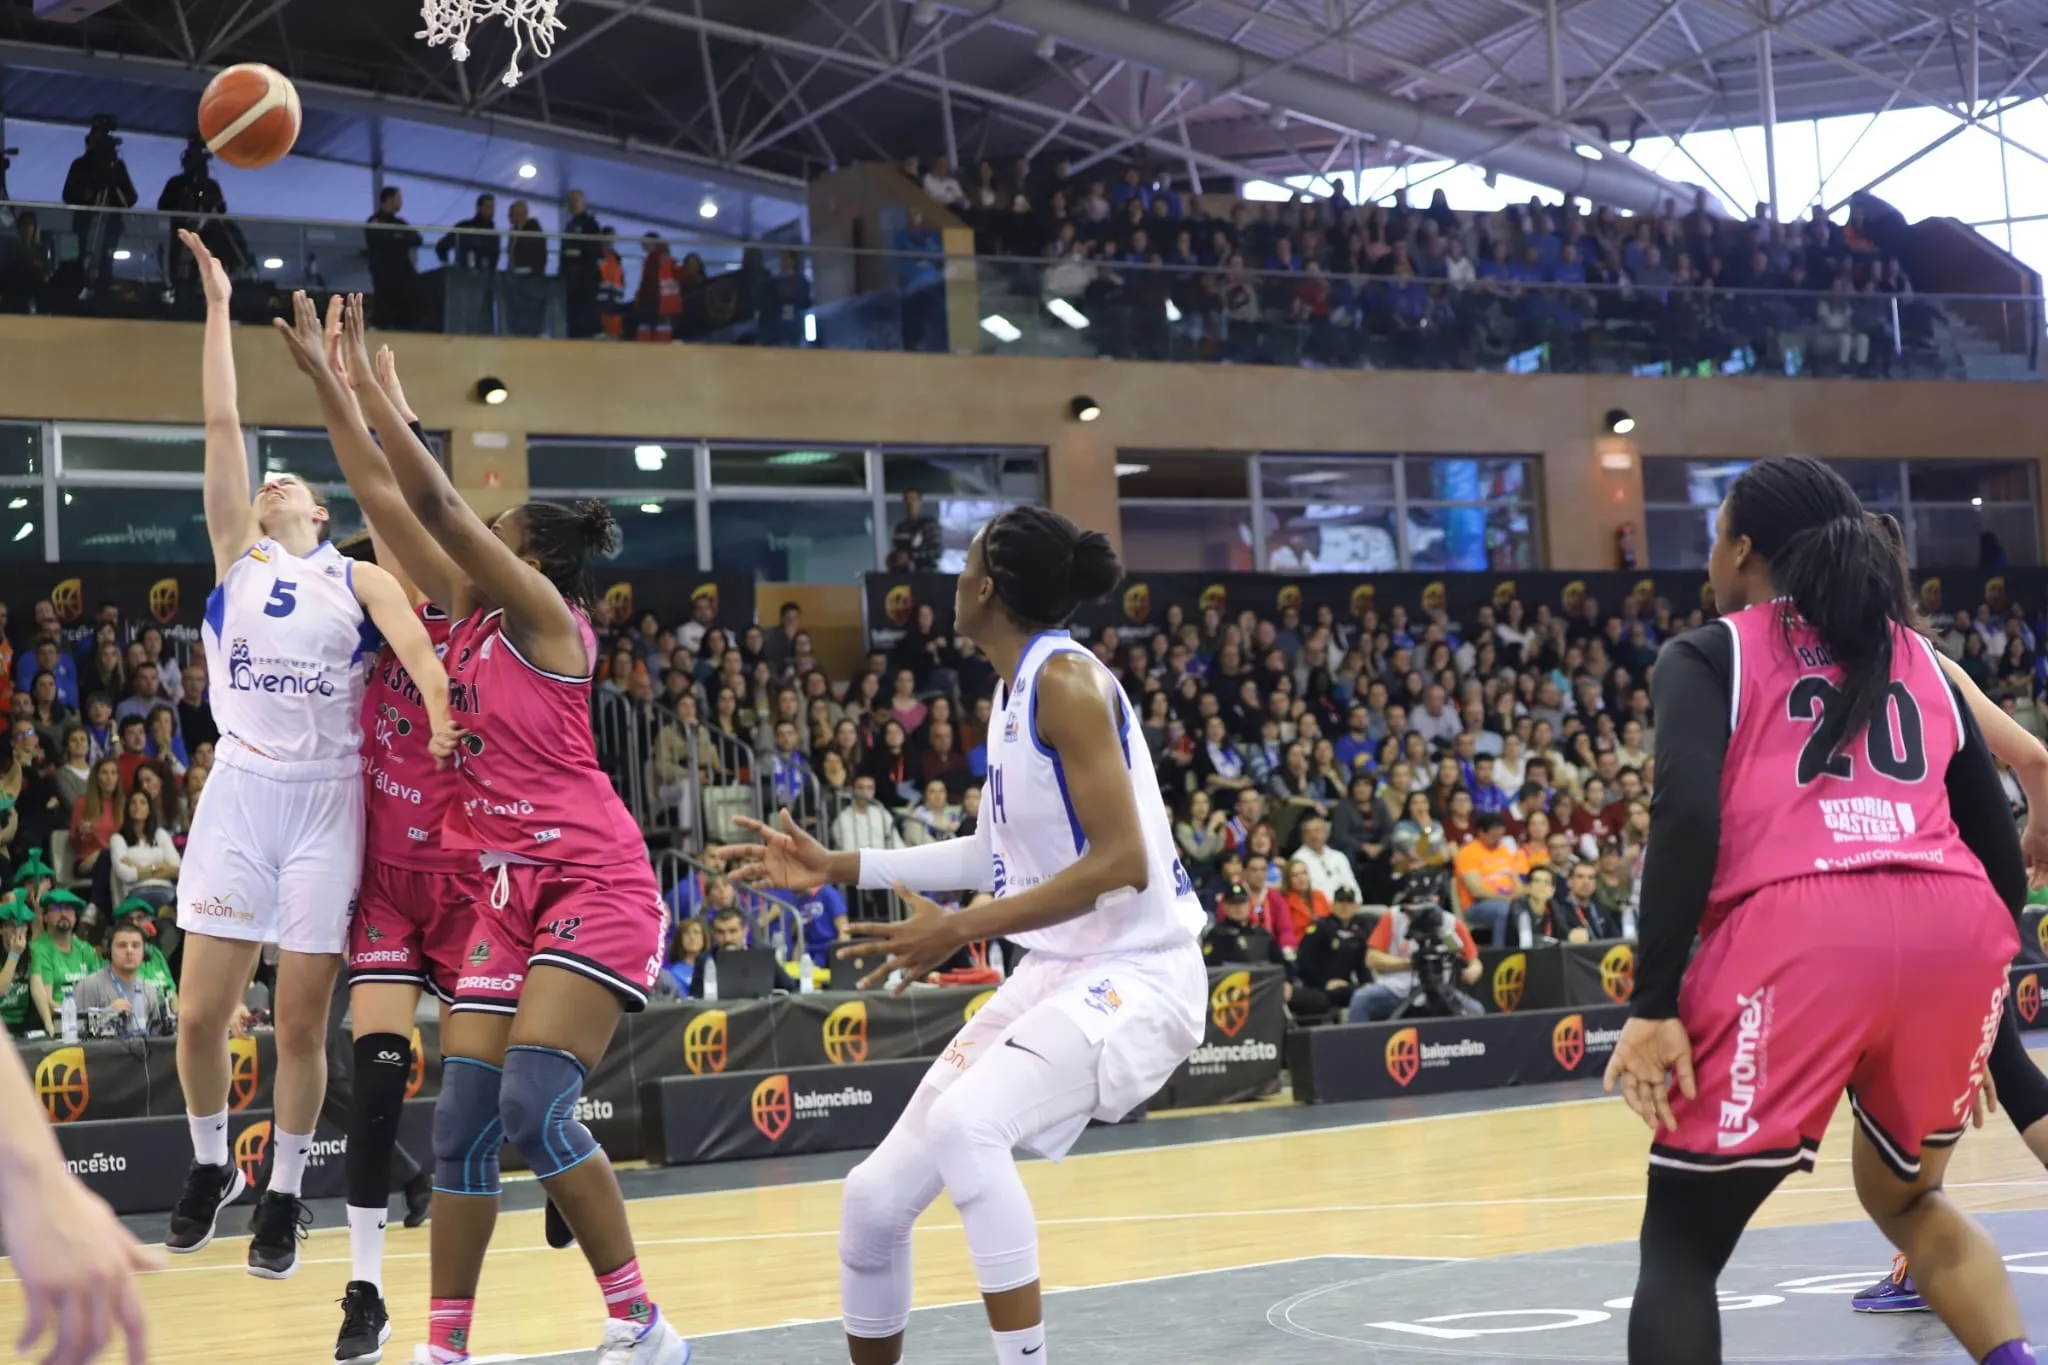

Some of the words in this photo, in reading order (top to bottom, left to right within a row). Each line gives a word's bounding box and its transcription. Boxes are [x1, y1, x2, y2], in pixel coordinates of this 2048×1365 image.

[263, 577, 297, 618] 5
[1787, 674, 1928, 787] 20
[1818, 796, 1895, 819] VITORIA
[1823, 812, 1900, 835] GASTEIZ
[357, 950, 408, 963] CORREO
[794, 1086, 873, 1110] baloncesto
[61, 1152, 127, 1176] ncesto
